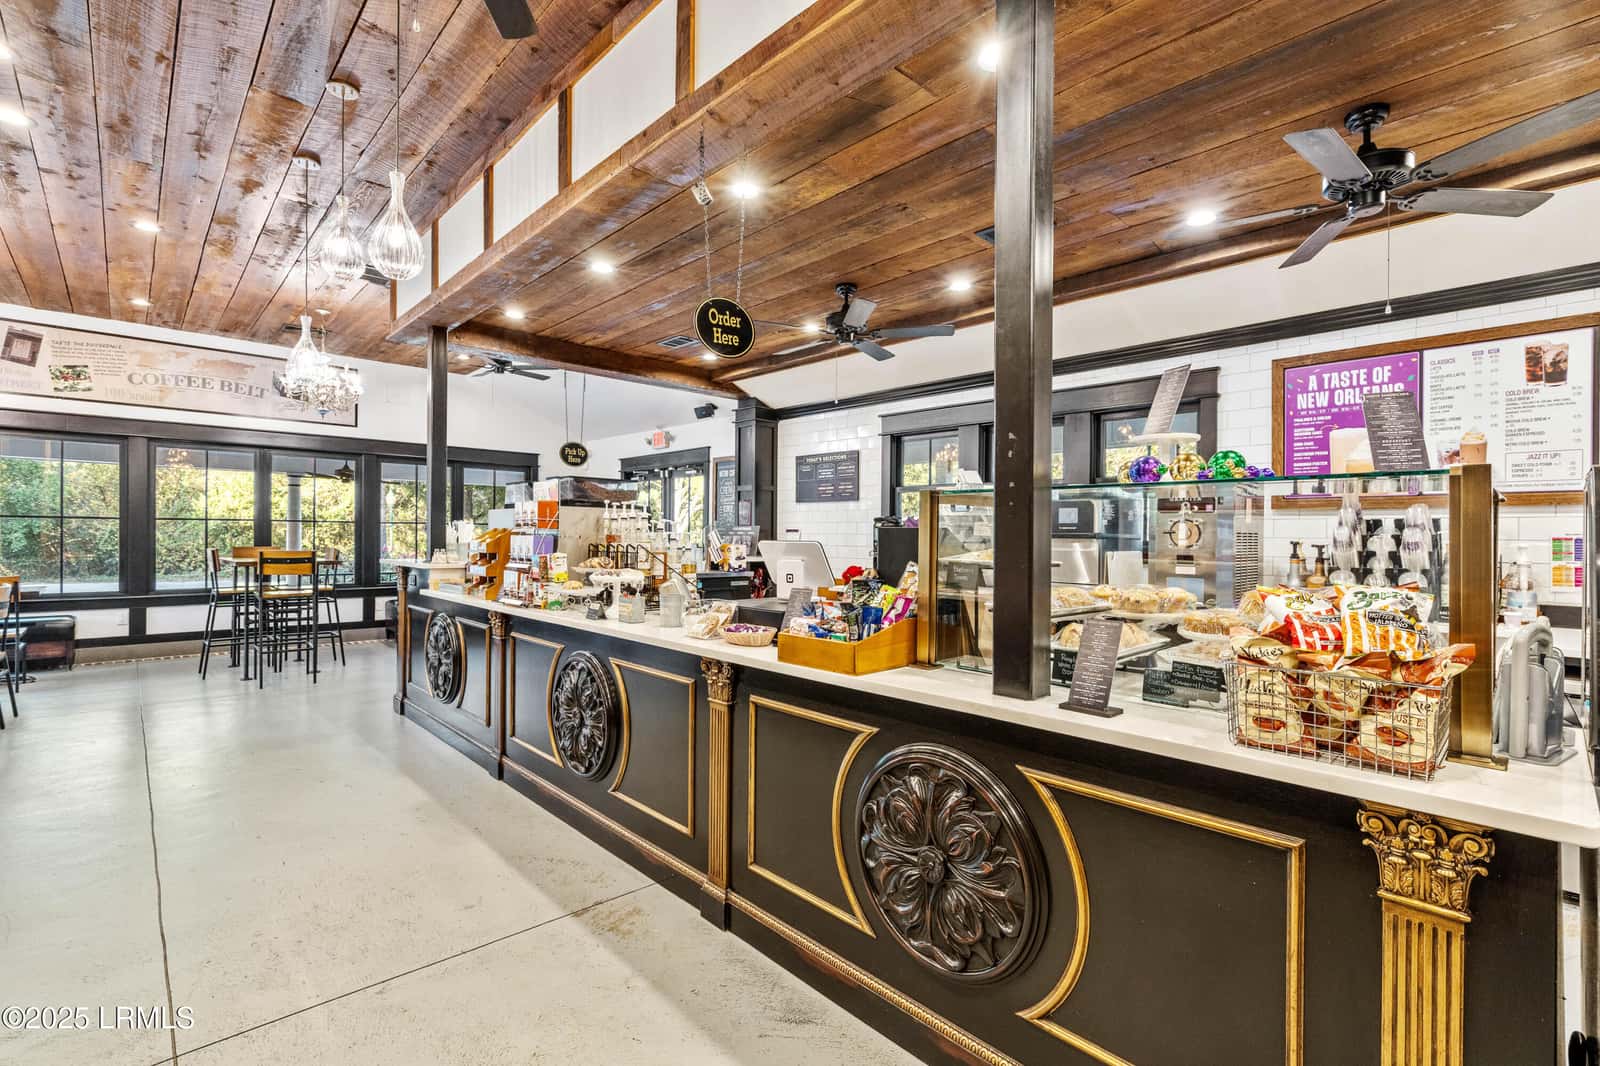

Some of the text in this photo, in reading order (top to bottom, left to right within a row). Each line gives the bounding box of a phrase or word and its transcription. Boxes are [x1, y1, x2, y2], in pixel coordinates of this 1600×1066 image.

[708, 308, 741, 328] Order
[713, 328, 739, 346] Here
[128, 372, 269, 399] COFFEE BELT
[1308, 365, 1392, 391] A TASTE OF
[1297, 391, 1329, 410] NEW
[1505, 389, 1521, 397] COLD
[578, 448, 585, 457] Up
